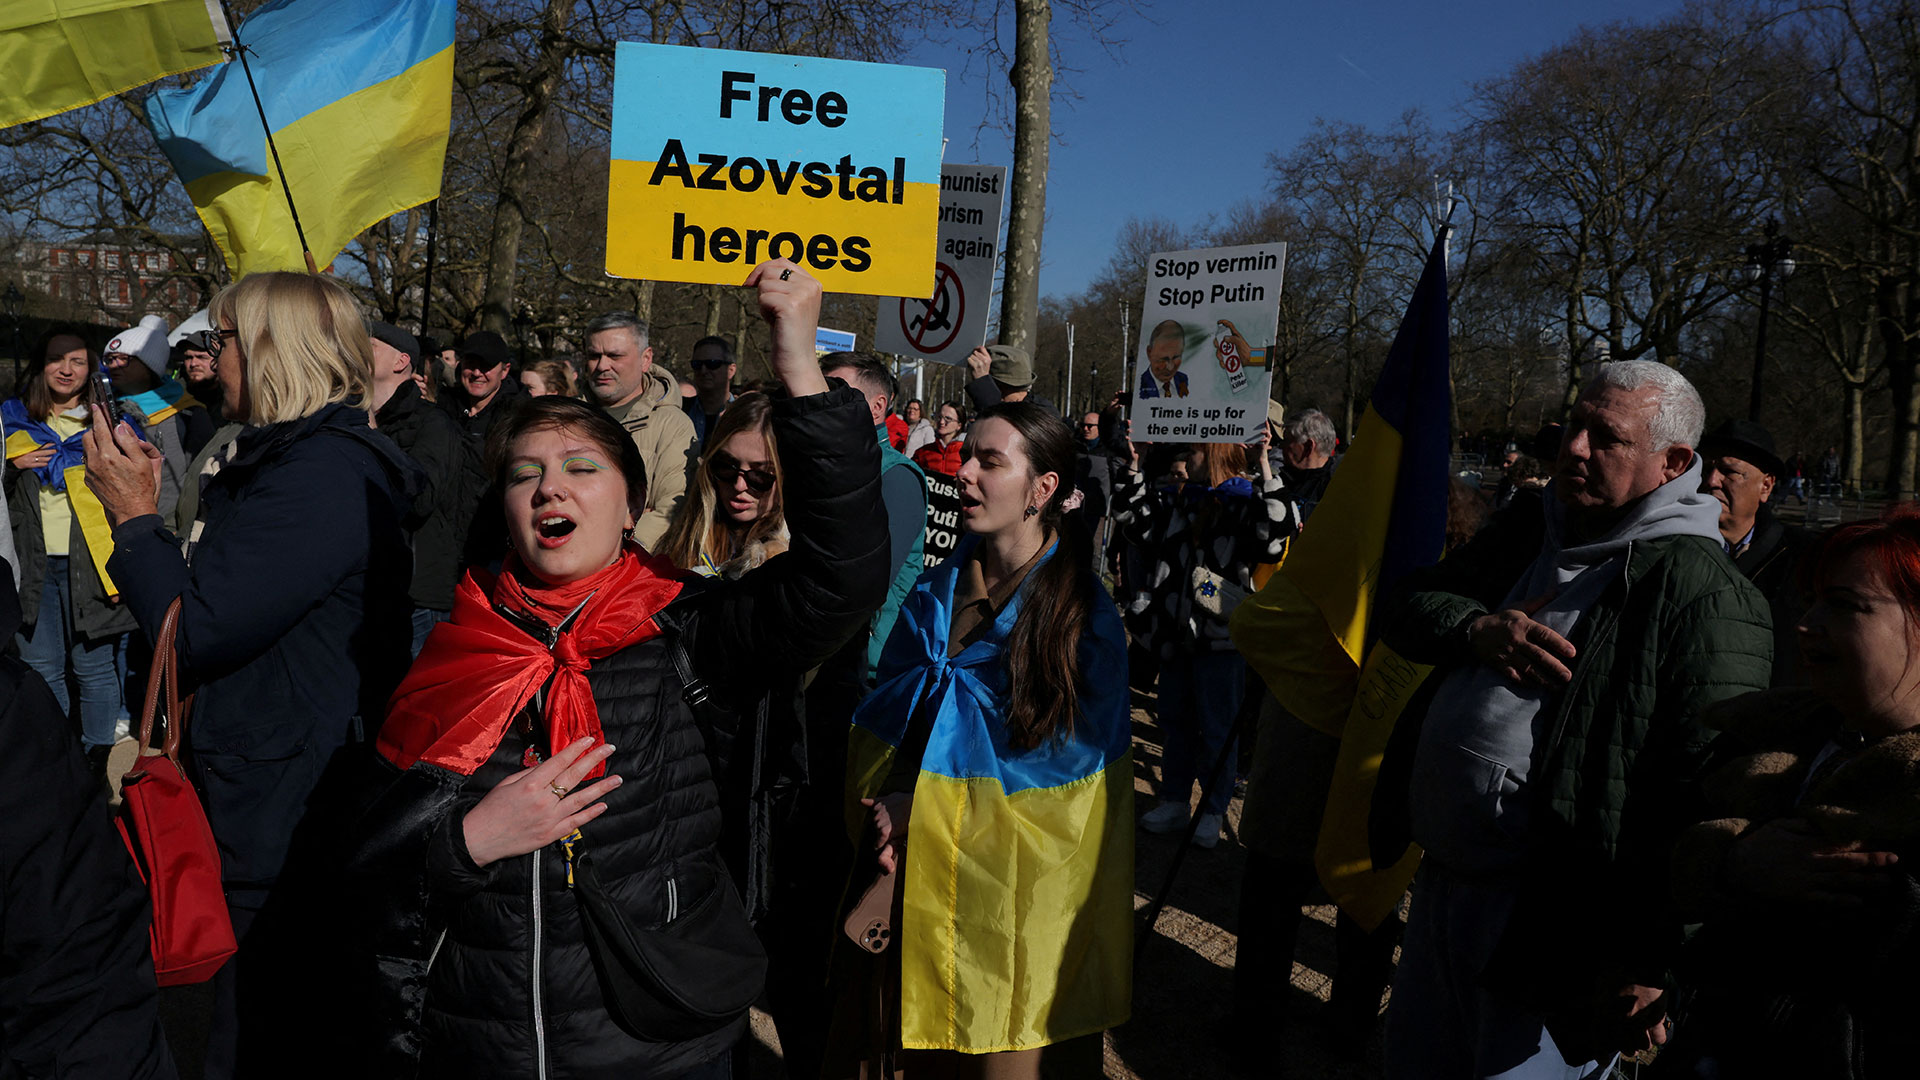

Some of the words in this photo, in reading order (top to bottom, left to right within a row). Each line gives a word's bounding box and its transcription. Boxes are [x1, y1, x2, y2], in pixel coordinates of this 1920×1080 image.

[719, 70, 848, 128] Free
[648, 138, 905, 205] Azovstal
[671, 212, 872, 273] heroes
[945, 237, 993, 260] again
[1154, 258, 1199, 280] Stop
[1206, 251, 1277, 273] vermin
[1158, 287, 1204, 309] Stop
[1210, 283, 1264, 303] Putin
[1150, 407, 1183, 418] Time
[1187, 407, 1198, 418] is
[1203, 408, 1221, 421] up
[1225, 406, 1245, 418] for
[1147, 424, 1169, 435] the
[1173, 424, 1197, 435] evil
[1200, 424, 1244, 438] goblin
[927, 504, 959, 528] Puti
